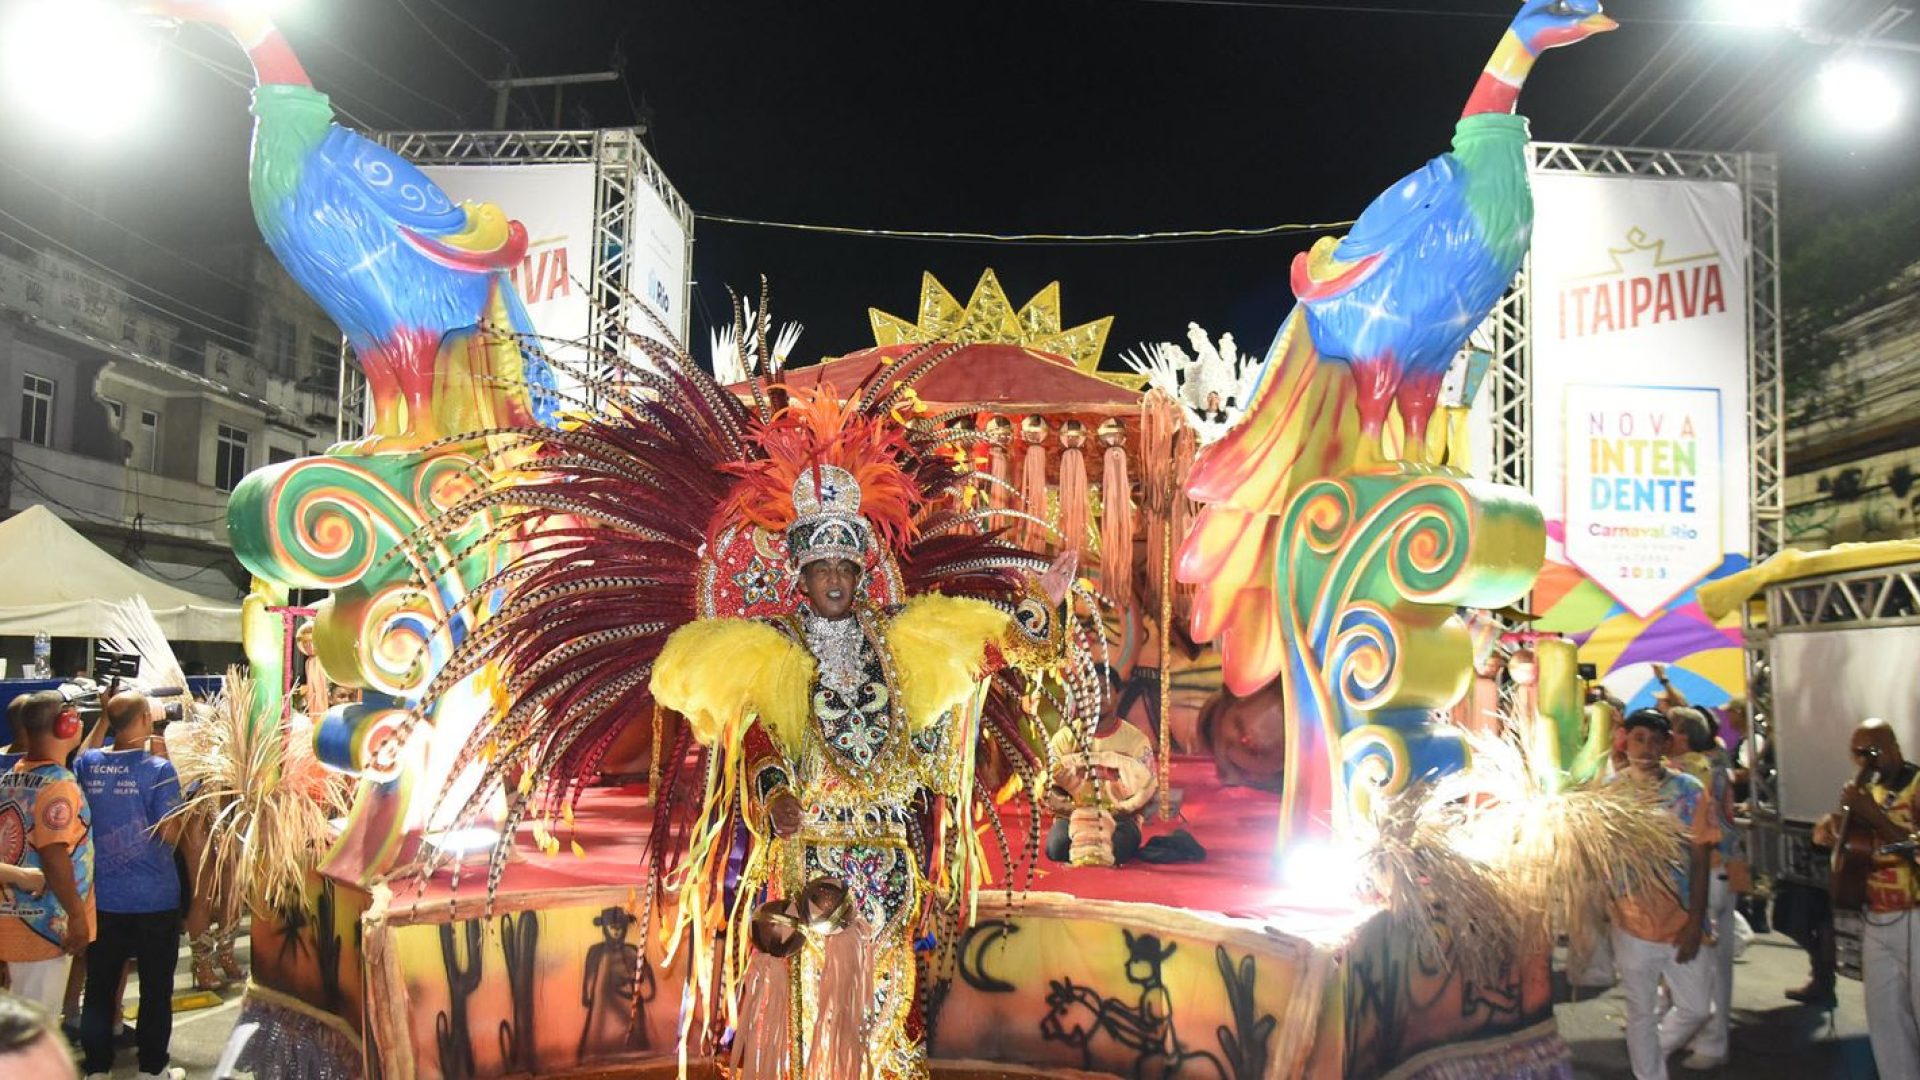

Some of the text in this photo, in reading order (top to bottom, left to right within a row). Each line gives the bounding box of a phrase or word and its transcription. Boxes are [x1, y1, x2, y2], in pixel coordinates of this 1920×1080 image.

[1558, 264, 1726, 340] ITAIPAVA
[1590, 412, 1695, 438] NOVA
[1590, 438, 1696, 477] INTEN
[1591, 477, 1696, 513] DENTE
